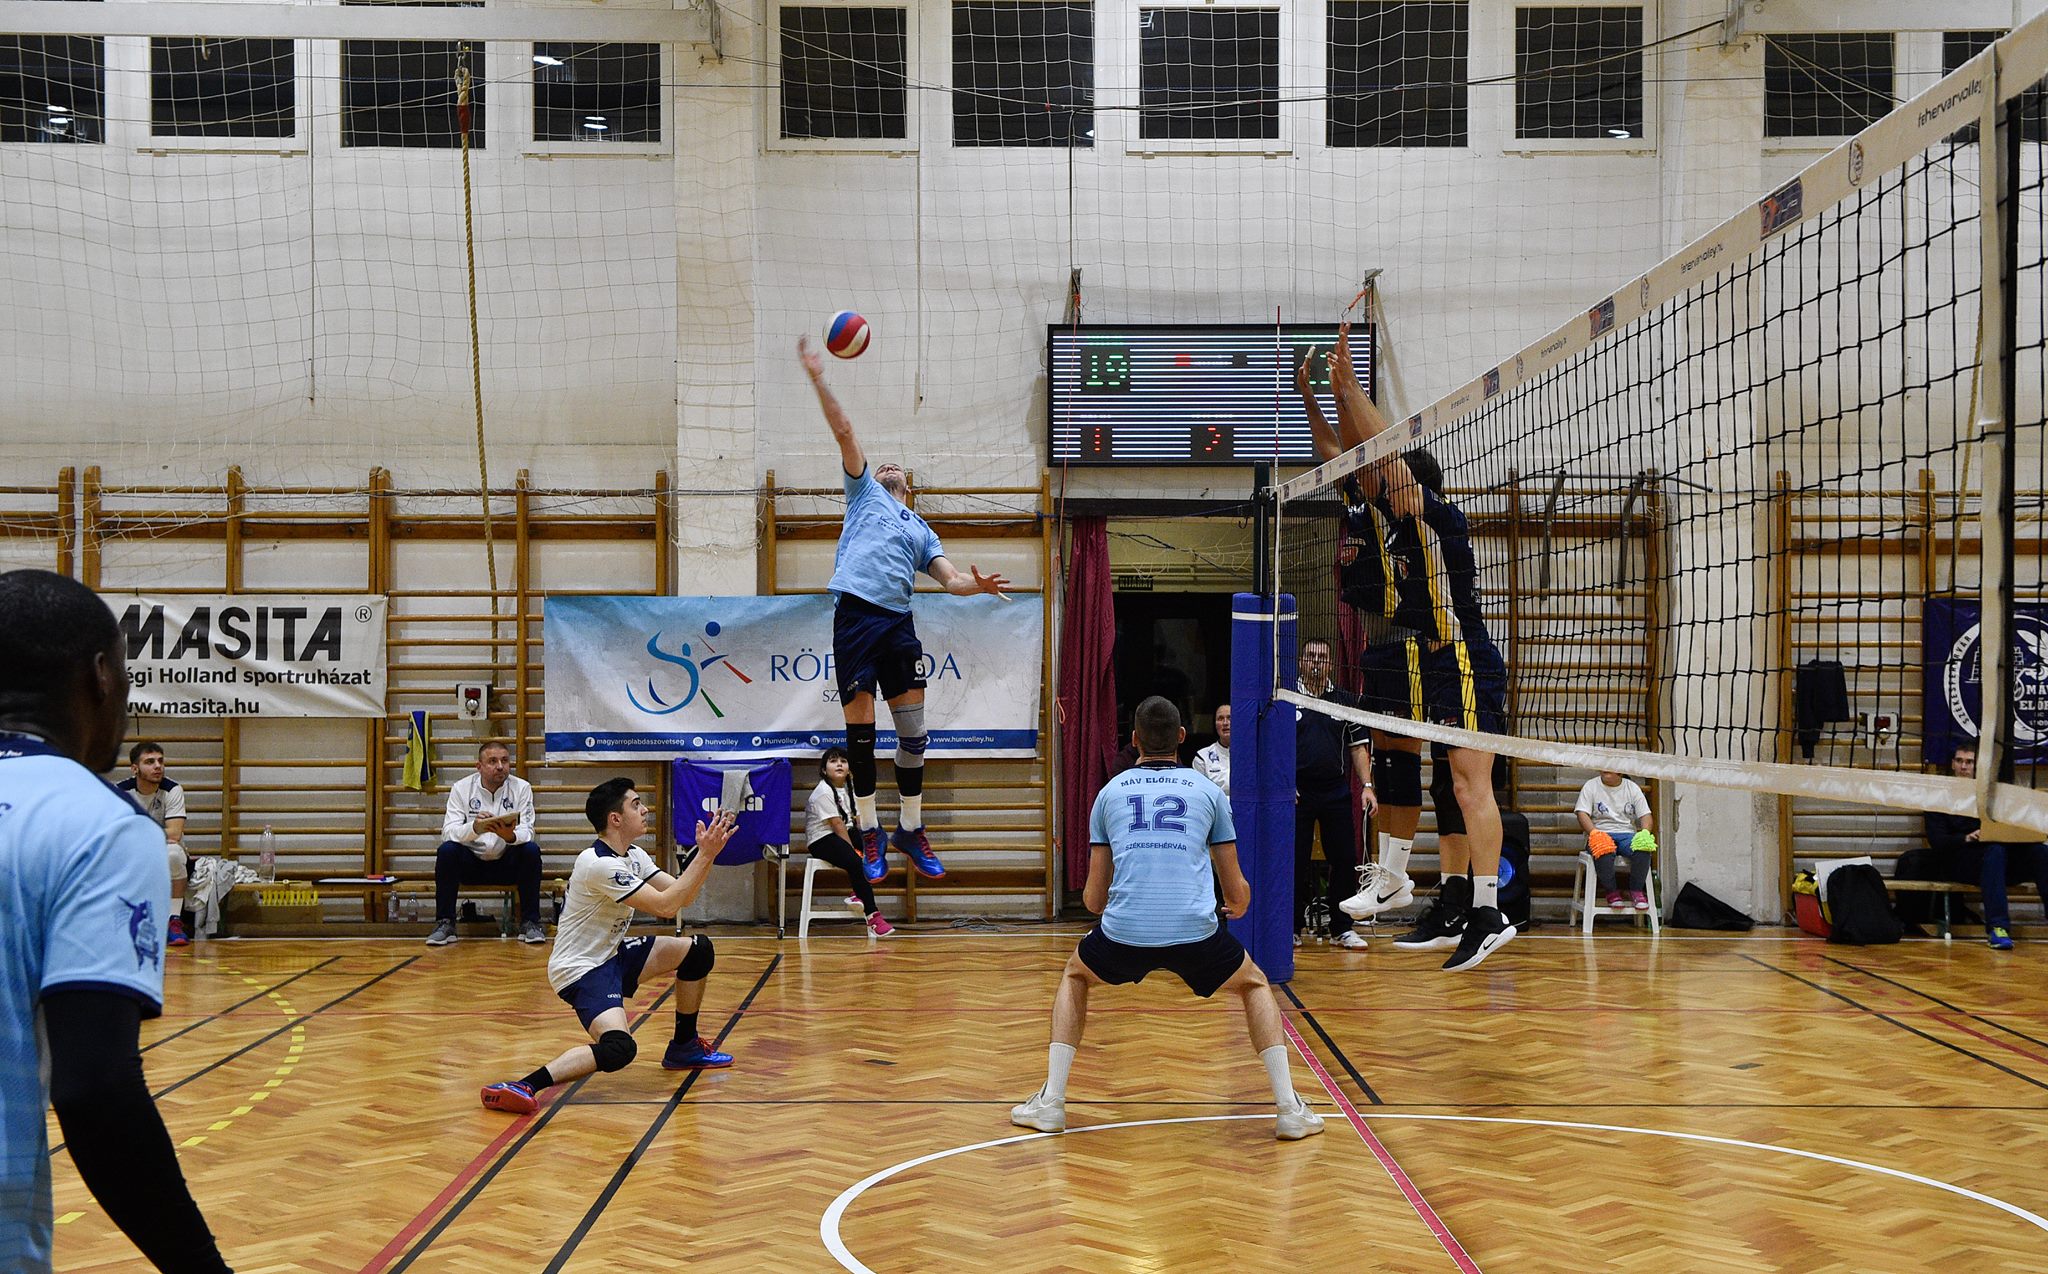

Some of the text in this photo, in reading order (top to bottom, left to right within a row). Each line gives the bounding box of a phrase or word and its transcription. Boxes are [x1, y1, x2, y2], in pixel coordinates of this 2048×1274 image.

[118, 604, 342, 662] MASITA
[915, 660, 924, 675] 6
[126, 667, 372, 688] égi Holland sportruházat
[127, 698, 260, 715] w.masita.hu
[705, 737, 739, 747] hunvolley
[763, 736, 798, 746] Hunvolley
[932, 735, 995, 745] www.hunvolley.hu
[1127, 794, 1188, 834] 12
